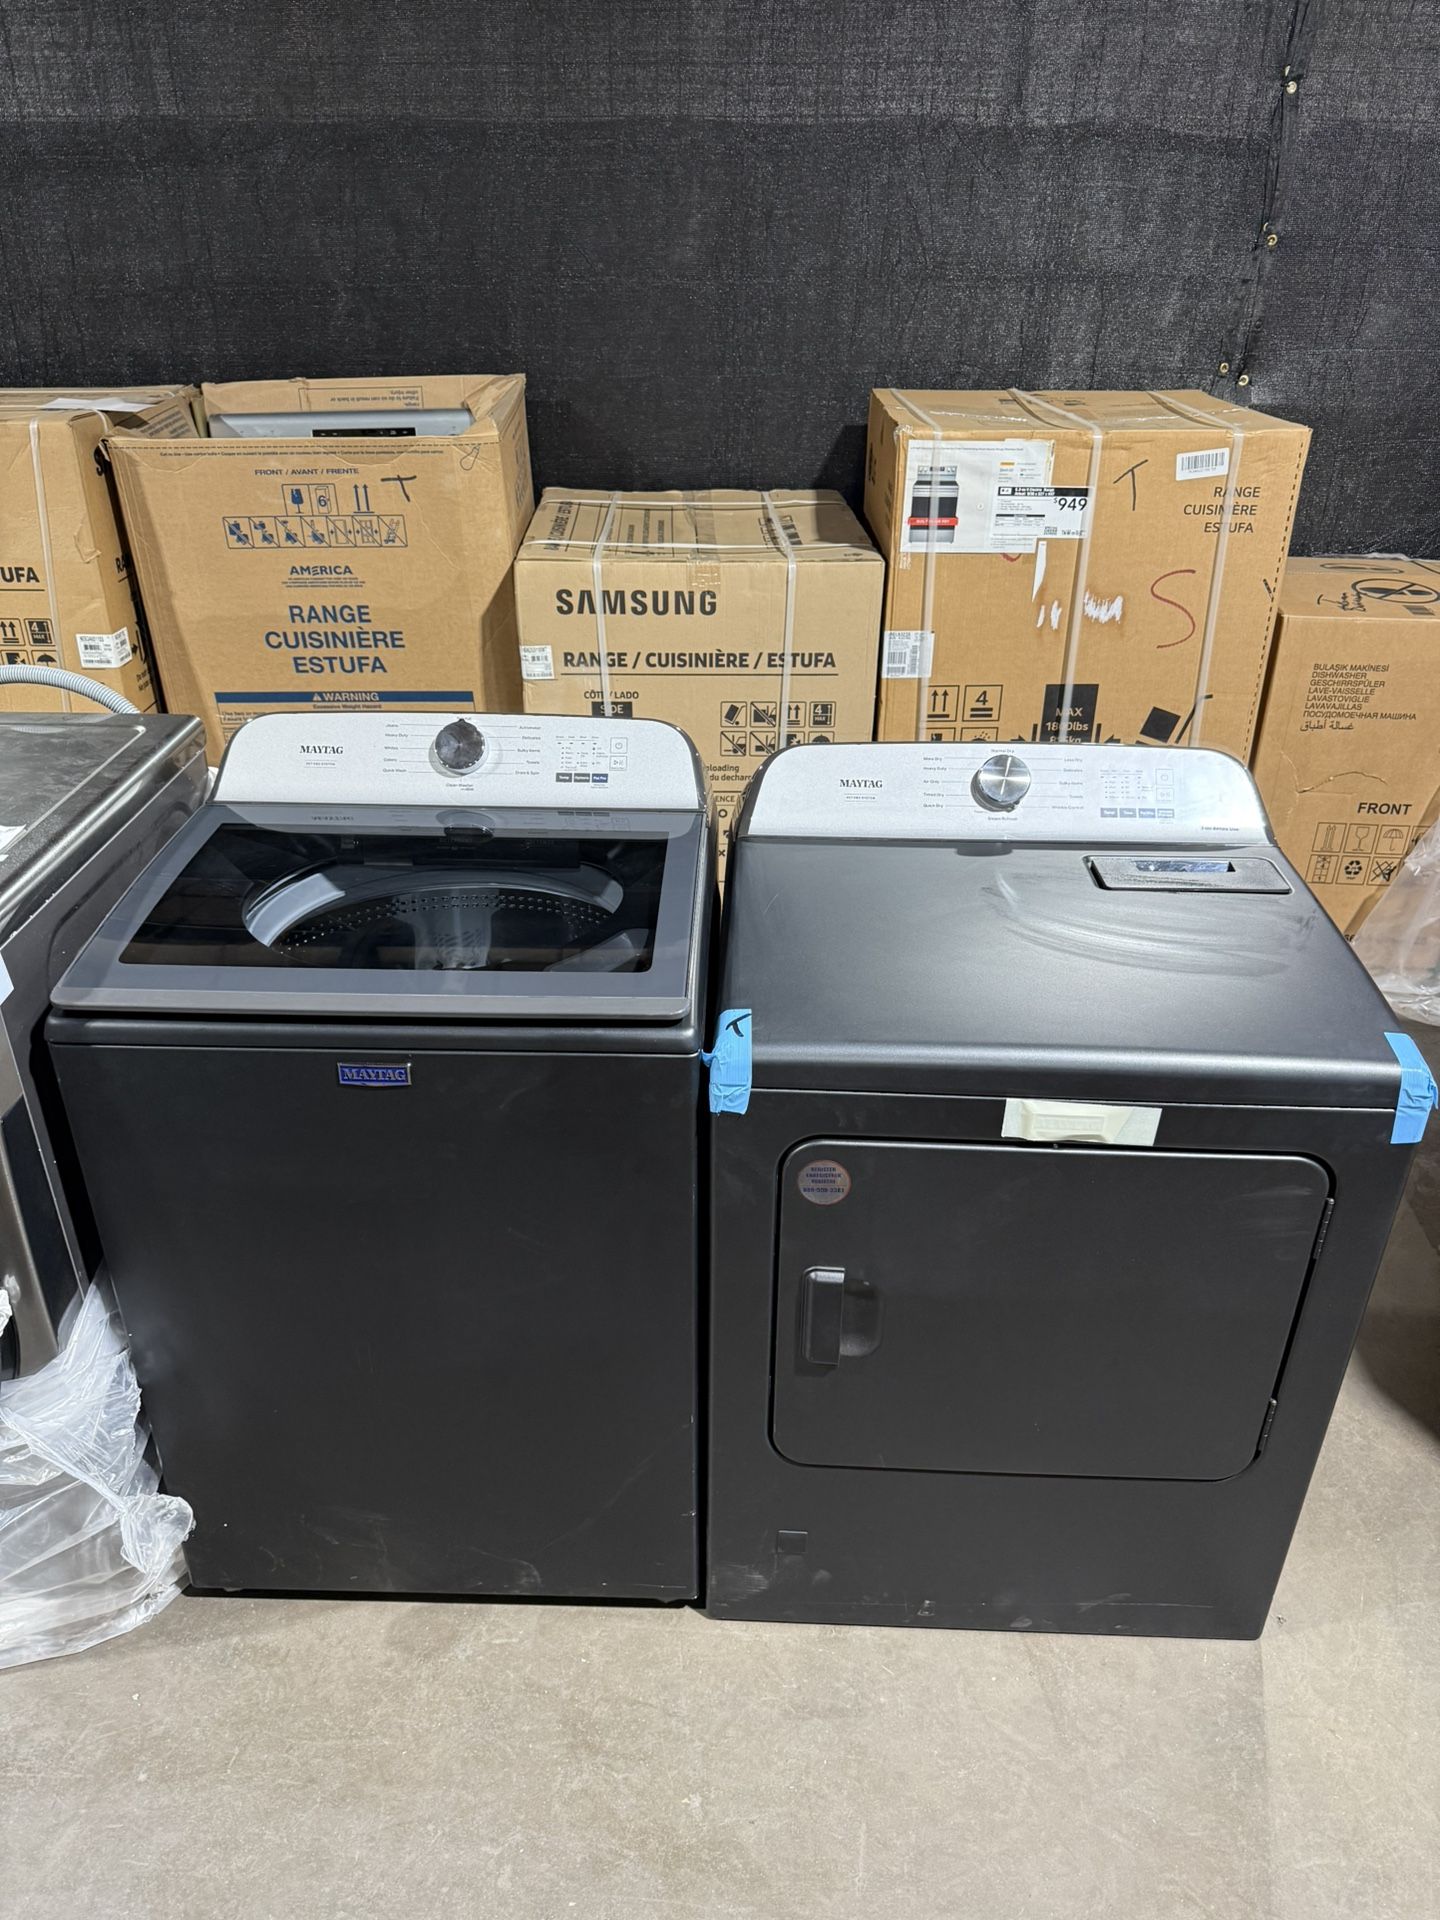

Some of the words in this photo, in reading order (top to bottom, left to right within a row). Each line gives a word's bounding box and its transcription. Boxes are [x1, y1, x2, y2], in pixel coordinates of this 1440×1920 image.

[1214, 486, 1262, 498] RNGE
[1204, 522, 1254, 533] ESUFA
[290, 566, 353, 576] AMERICA
[556, 588, 717, 616] SAMSUNG
[288, 604, 372, 624] RANGE
[264, 626, 406, 649] CUISINIÈRE
[564, 652, 628, 668] RANGE
[632, 651, 642, 669] /
[646, 648, 750, 668] CUISINIÈRE
[753, 652, 764, 669] /
[292, 656, 388, 674] ESTUFA
[1311, 672, 1368, 680] DISHWASHER
[1310, 679, 1386, 688] GESCHIRRSPÜLER
[322, 692, 380, 702] WARNING
[584, 689, 604, 700] CÔT
[614, 690, 640, 700] LADO
[1308, 688, 1376, 696] LAVE-VAISSELLE
[976, 690, 988, 706] 4
[1306, 695, 1370, 703] LAVASTOVIGLIE
[600, 704, 624, 714] SDE
[815, 704, 822, 714] 4
[1304, 702, 1362, 710] LAVAVAJILLAS
[1303, 710, 1378, 720] ПОСУДОМОЕЧНАЯ
[1046, 722, 1089, 732] 180lbs
[299, 745, 344, 754] MAYTAG
[840, 778, 883, 788] MAYTAG
[1357, 802, 1412, 815] FRONT
[342, 1068, 406, 1080] MAYTAG
